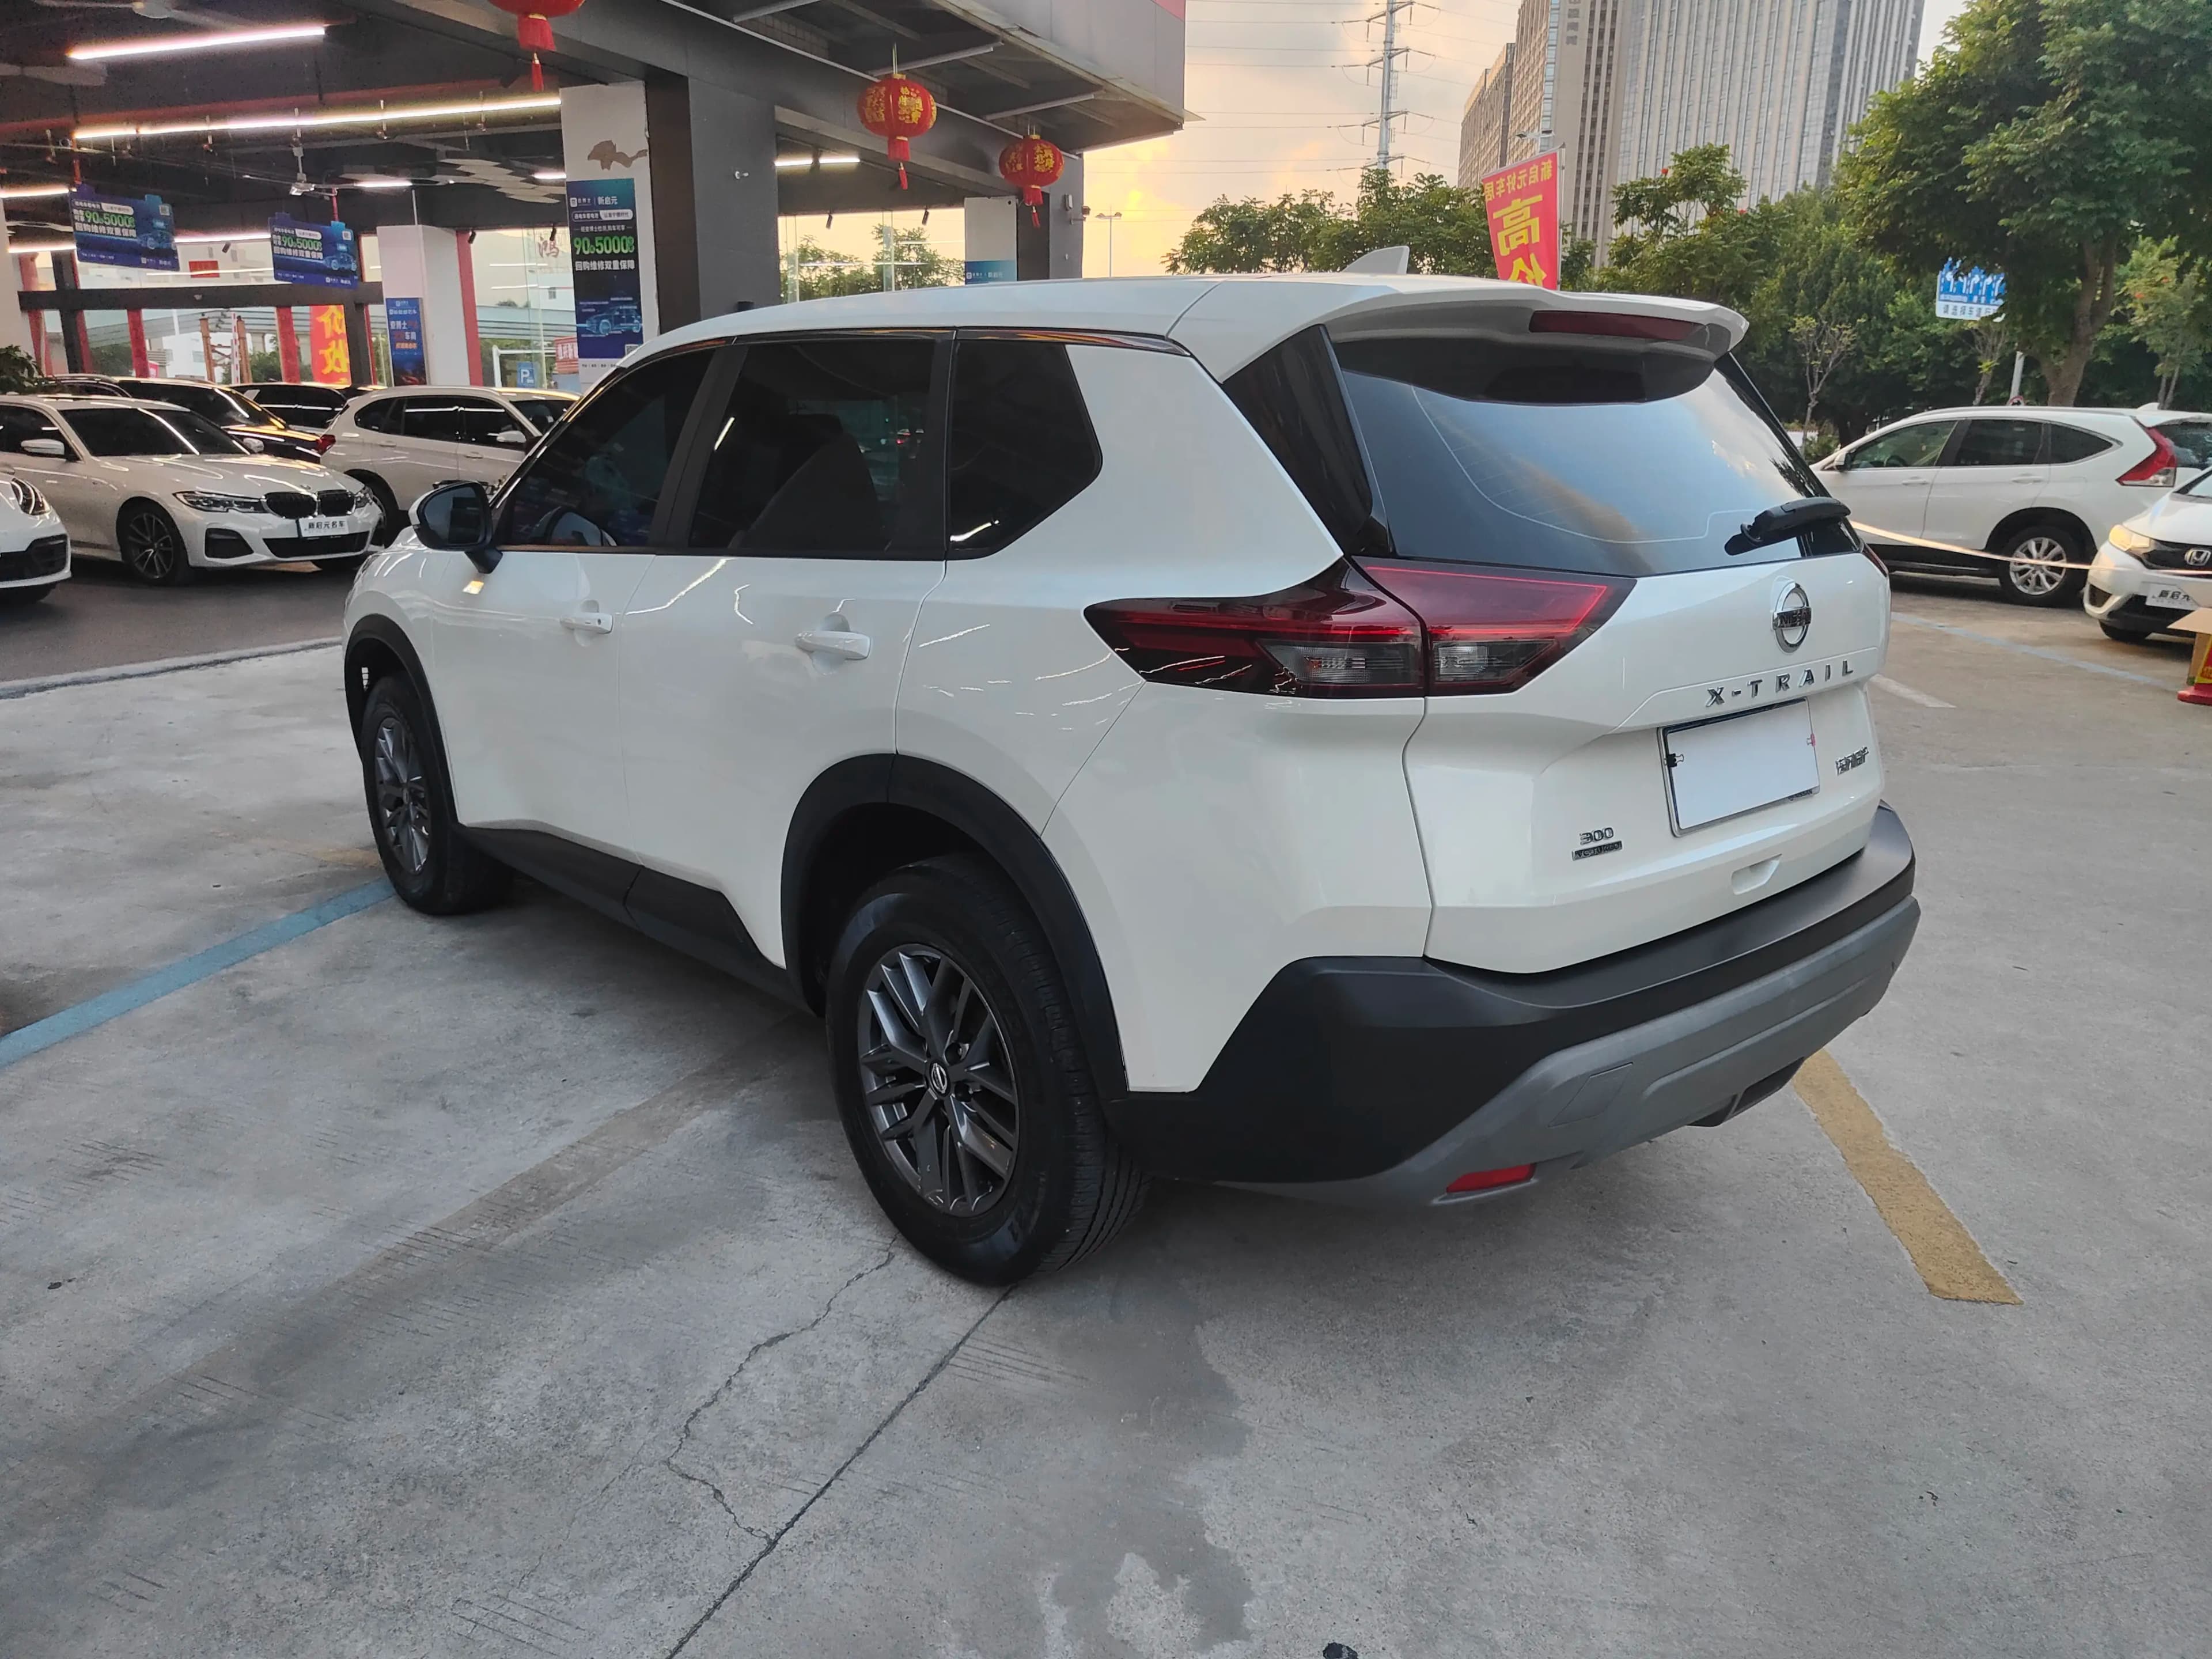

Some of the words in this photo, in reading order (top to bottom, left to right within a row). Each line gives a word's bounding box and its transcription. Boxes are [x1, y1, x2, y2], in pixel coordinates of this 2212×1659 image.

[521, 369, 530, 383] P
[1706, 659, 1854, 707] X-TRAIL
[1579, 827, 1614, 845] 300
